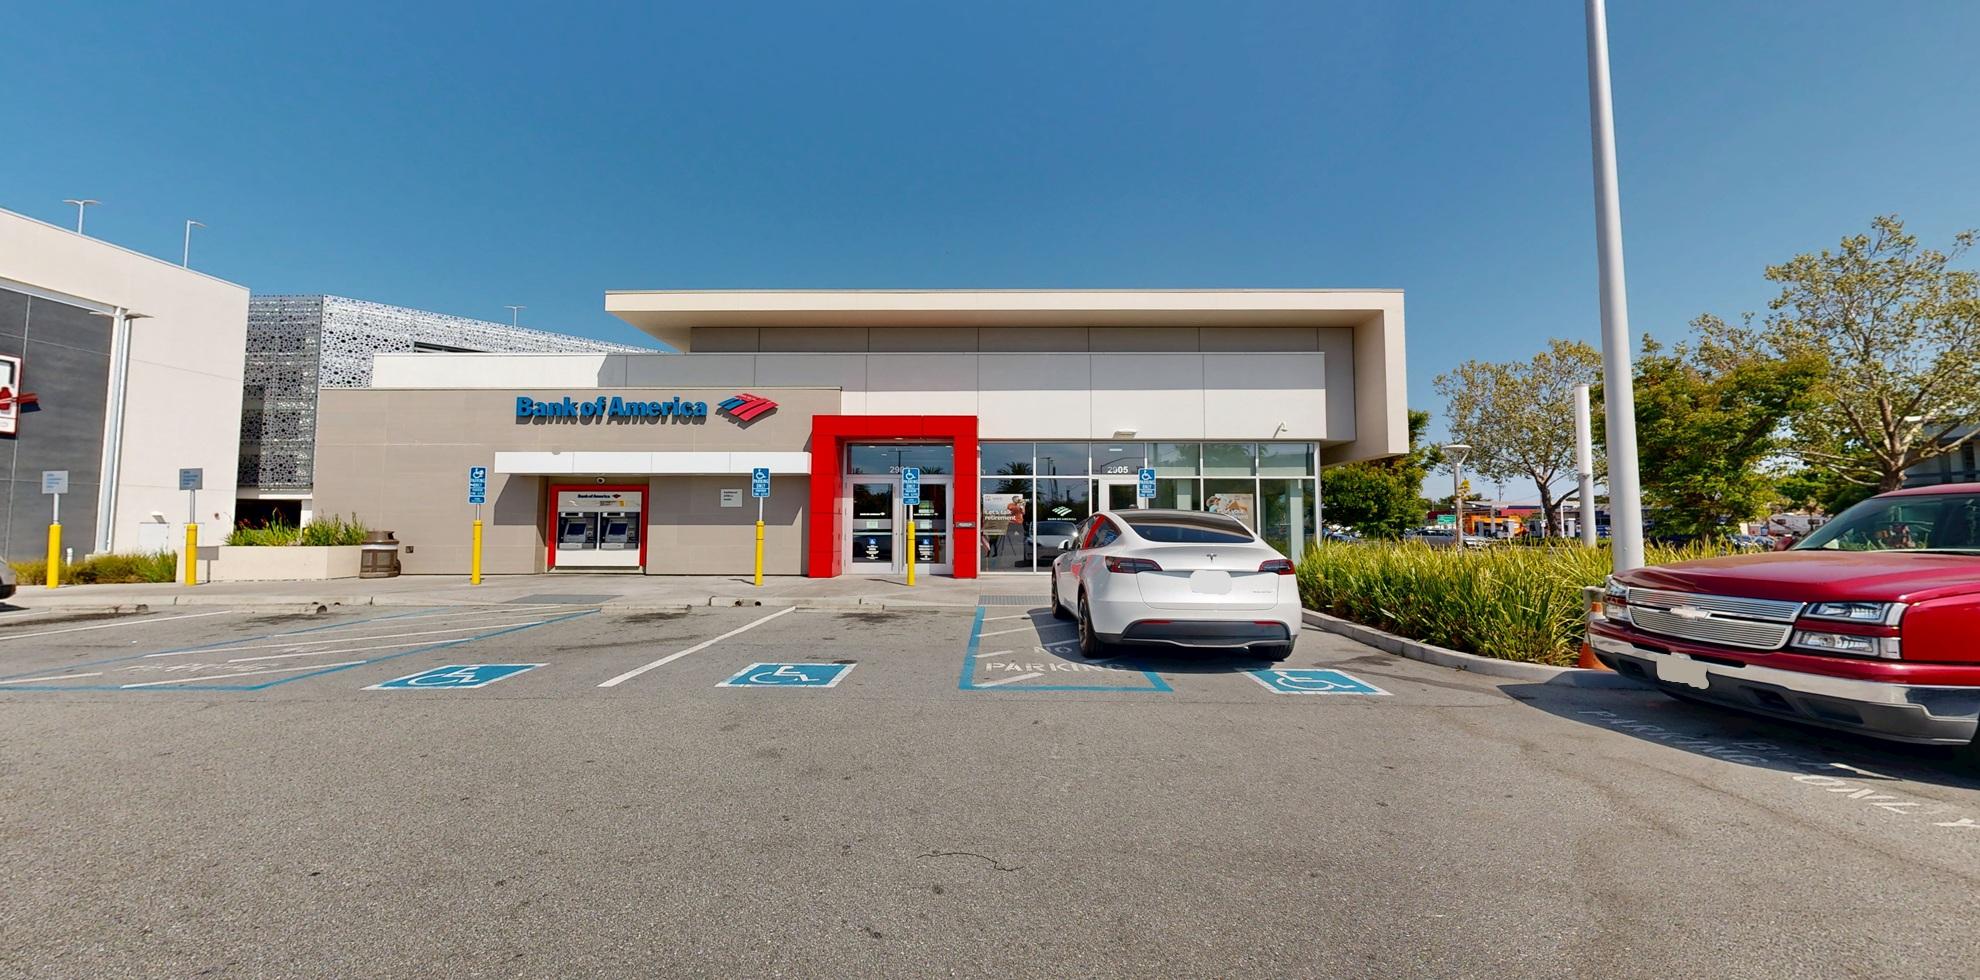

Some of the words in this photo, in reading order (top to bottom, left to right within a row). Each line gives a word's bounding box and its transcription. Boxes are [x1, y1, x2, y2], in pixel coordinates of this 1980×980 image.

[516, 396, 578, 416] Bank
[580, 396, 607, 416] of
[607, 396, 708, 416] America
[986, 662, 1126, 672] PARKING
